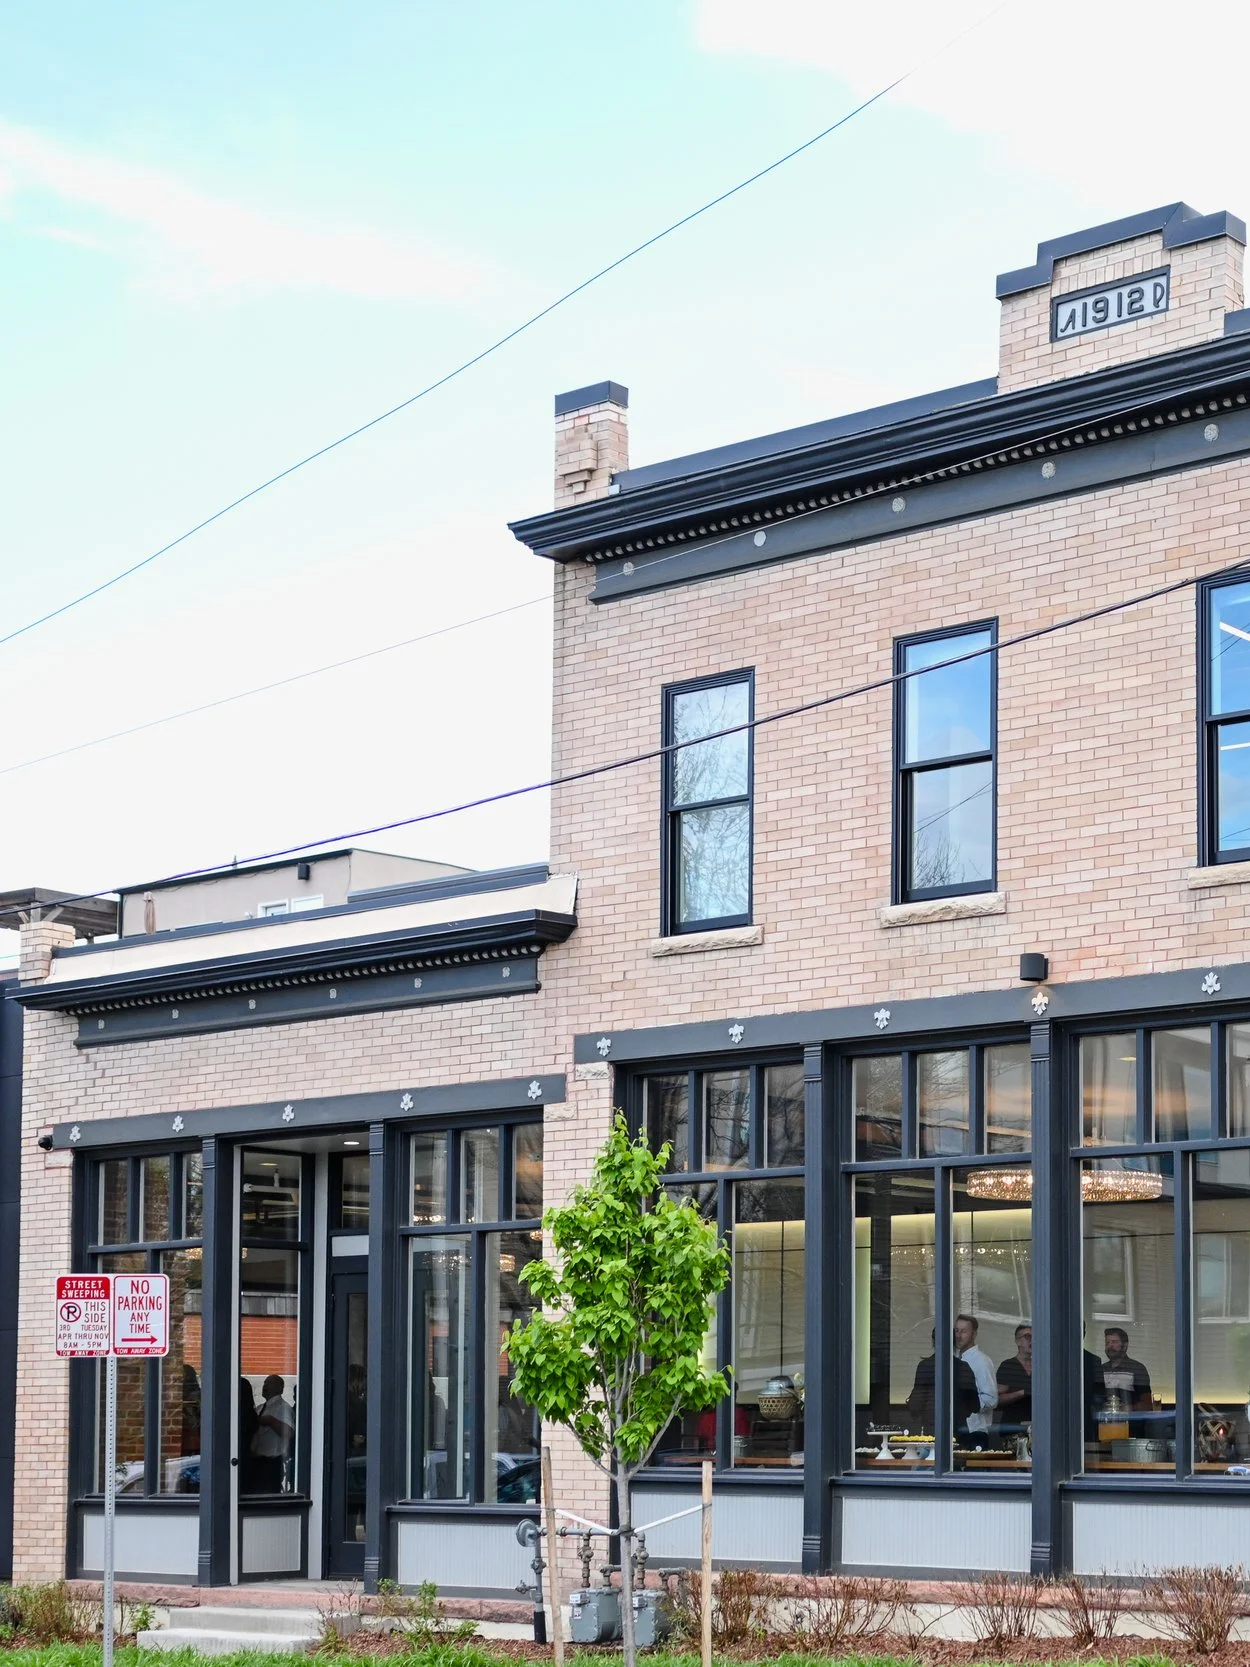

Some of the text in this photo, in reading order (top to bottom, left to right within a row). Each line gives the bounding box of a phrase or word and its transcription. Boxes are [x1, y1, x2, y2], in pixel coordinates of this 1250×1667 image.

[65, 1280, 102, 1289] STREET
[131, 1280, 149, 1294] NO
[62, 1290, 105, 1298] SWEEPING
[85, 1301, 106, 1311] THIS
[118, 1296, 162, 1310] PARKING
[84, 1313, 105, 1323] SIDE
[130, 1313, 149, 1322] ANY
[130, 1324, 150, 1333] TIME
